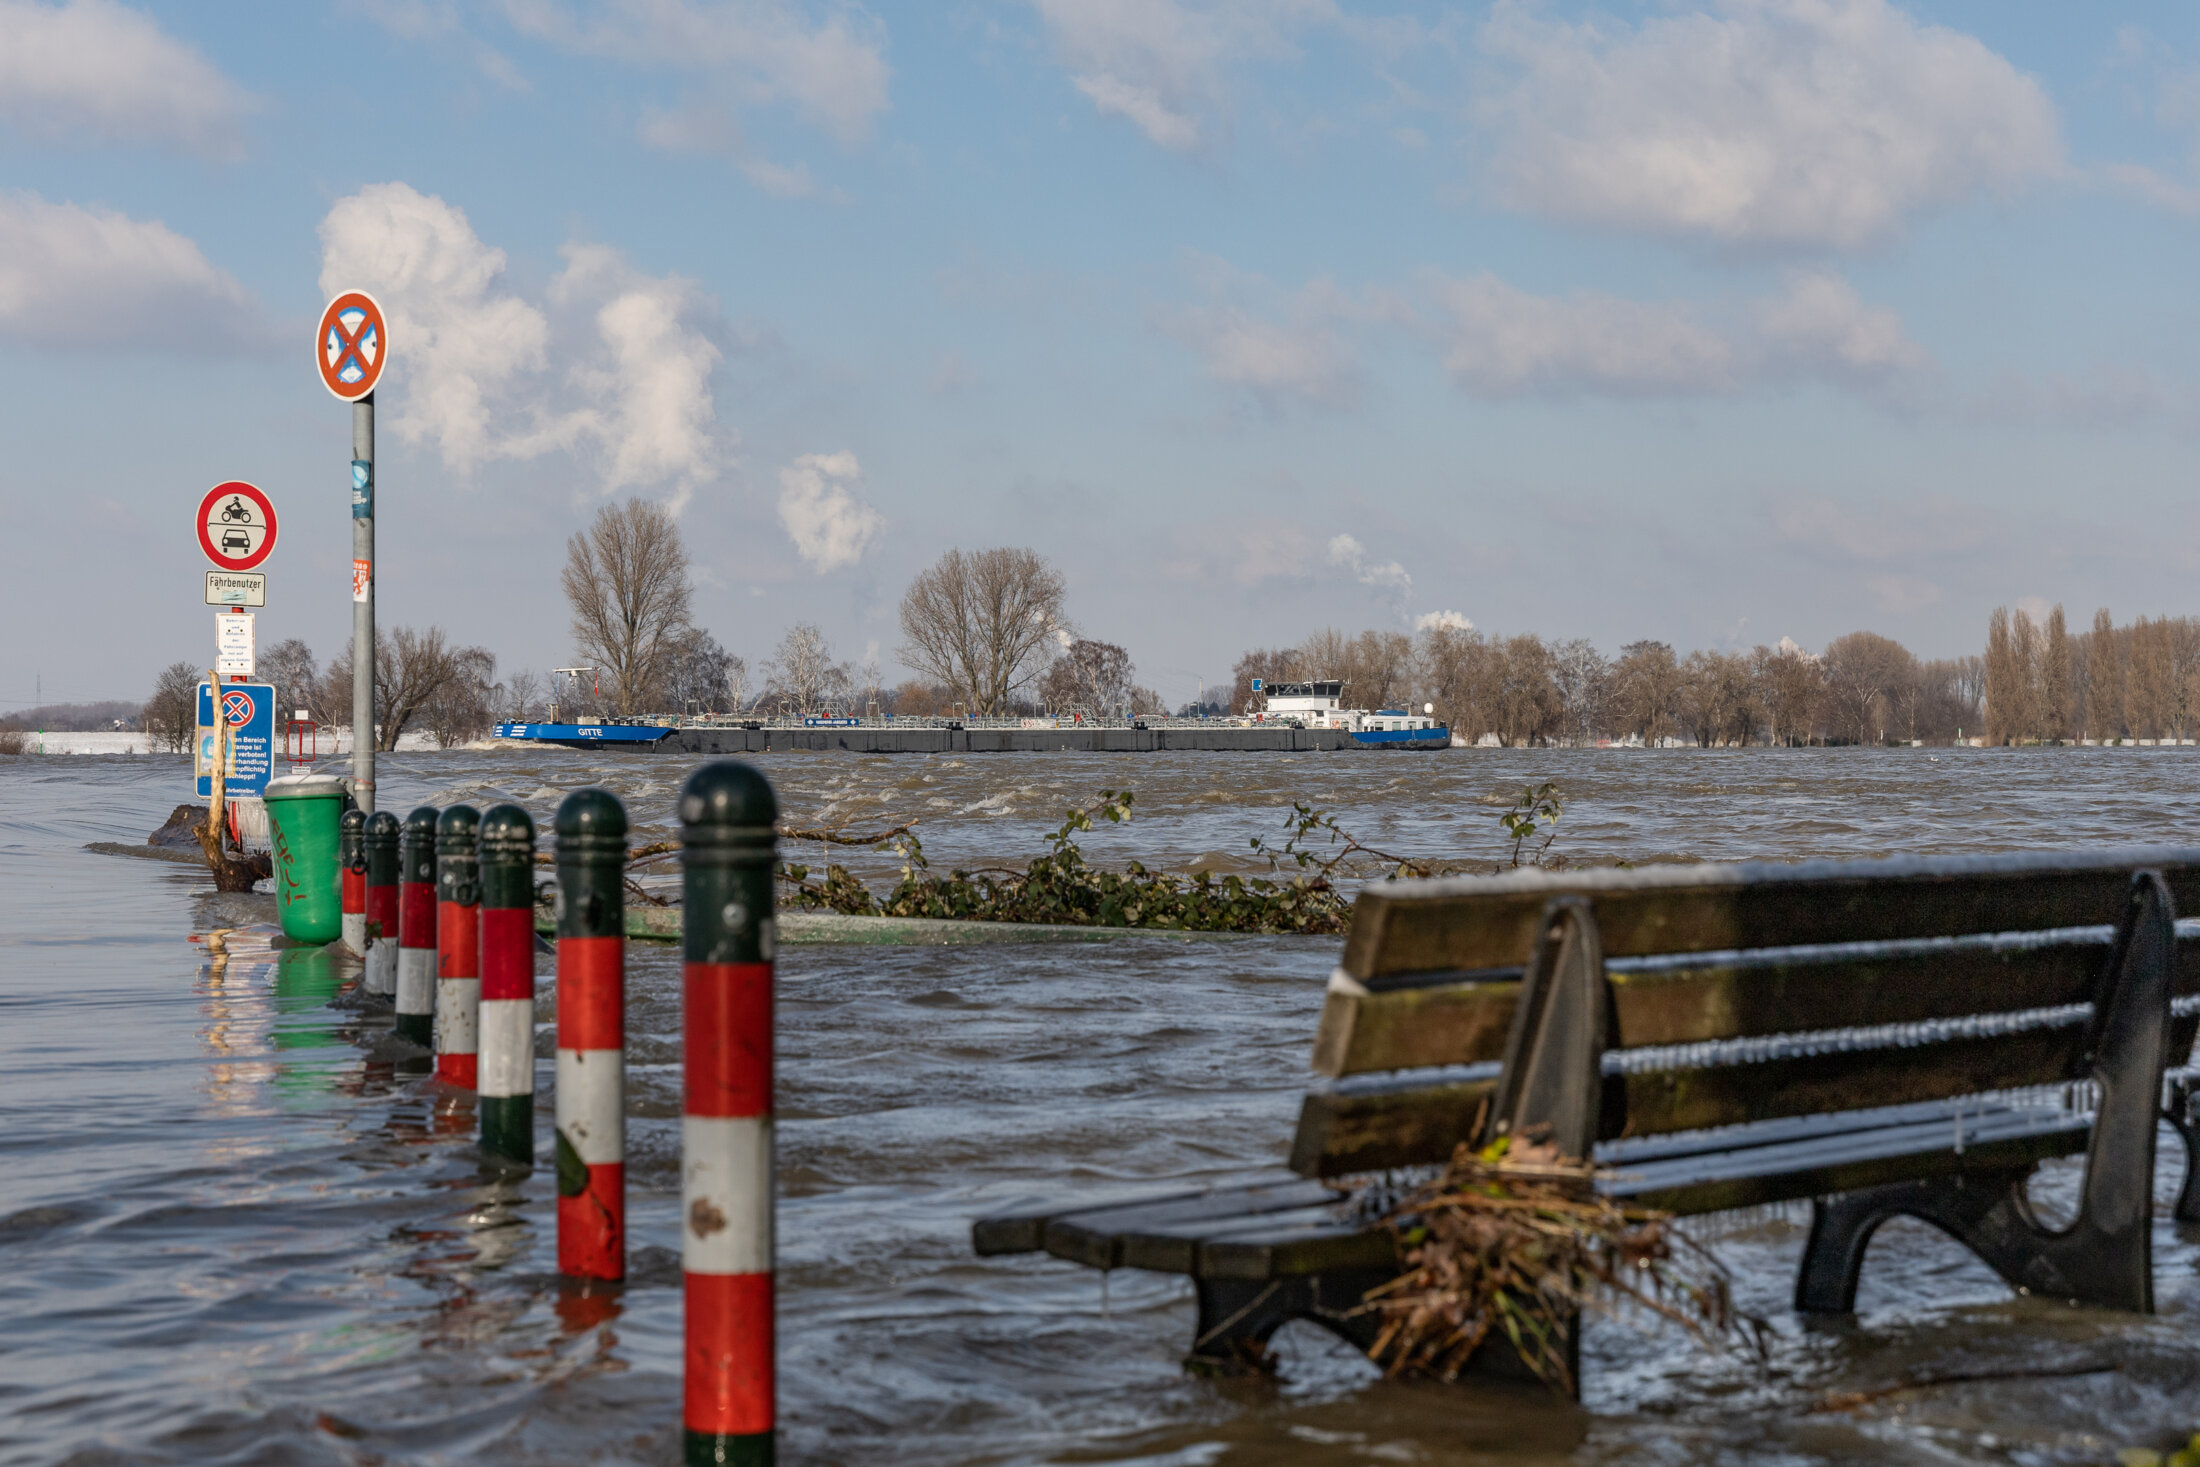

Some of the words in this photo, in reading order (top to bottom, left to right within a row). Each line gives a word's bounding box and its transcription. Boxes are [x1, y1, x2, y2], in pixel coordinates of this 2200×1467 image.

[210, 576, 261, 588] Fährbenutzer
[578, 728, 603, 736] GITTE
[243, 736, 267, 744] Bereich
